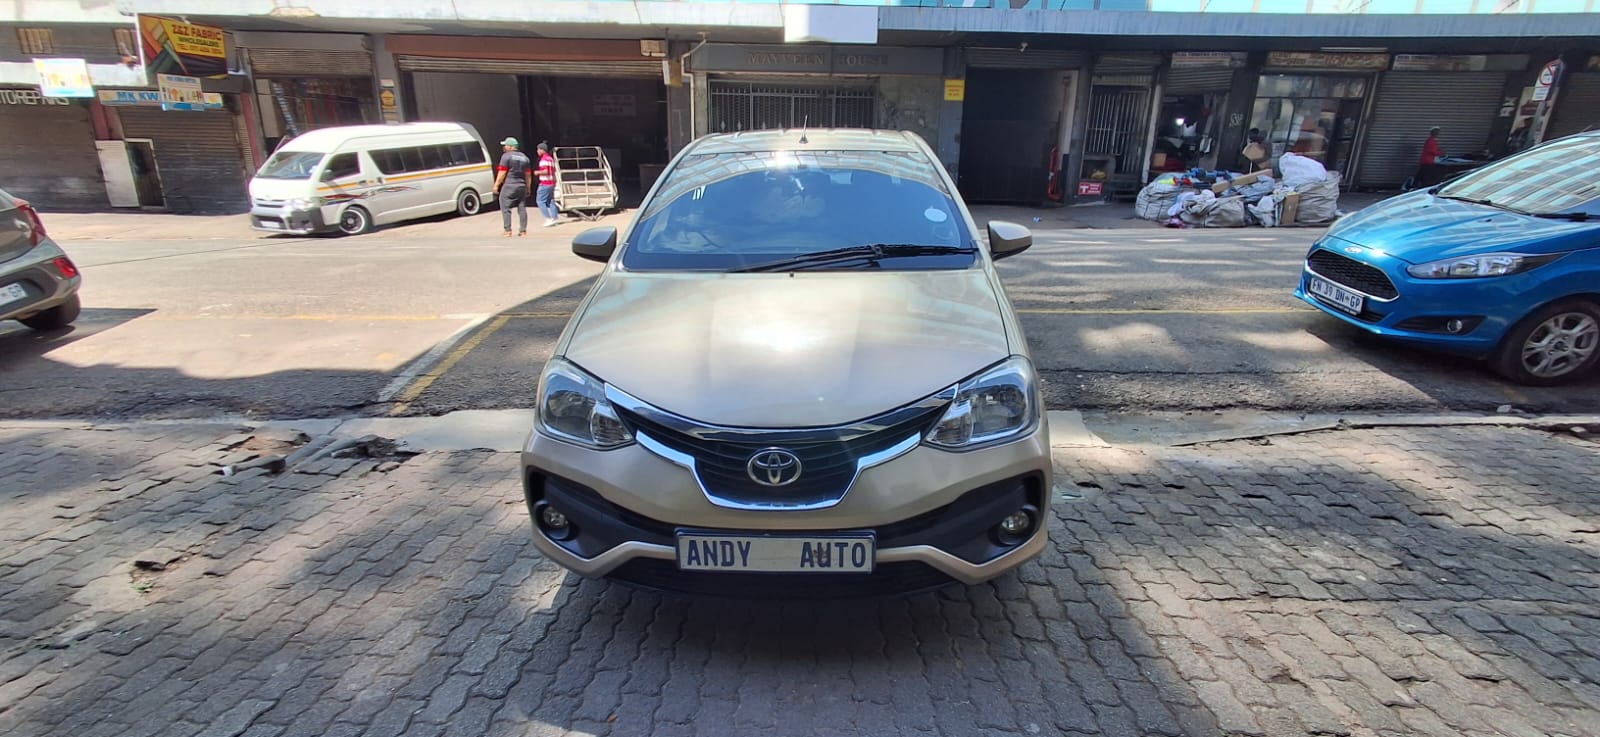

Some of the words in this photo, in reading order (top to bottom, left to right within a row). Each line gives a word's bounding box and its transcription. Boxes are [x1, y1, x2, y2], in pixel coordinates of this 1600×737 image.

[191, 27, 222, 41] FABRIC
[1350, 296, 1361, 309] GP
[687, 539, 752, 567] ANDY
[800, 541, 867, 568] AUTO
